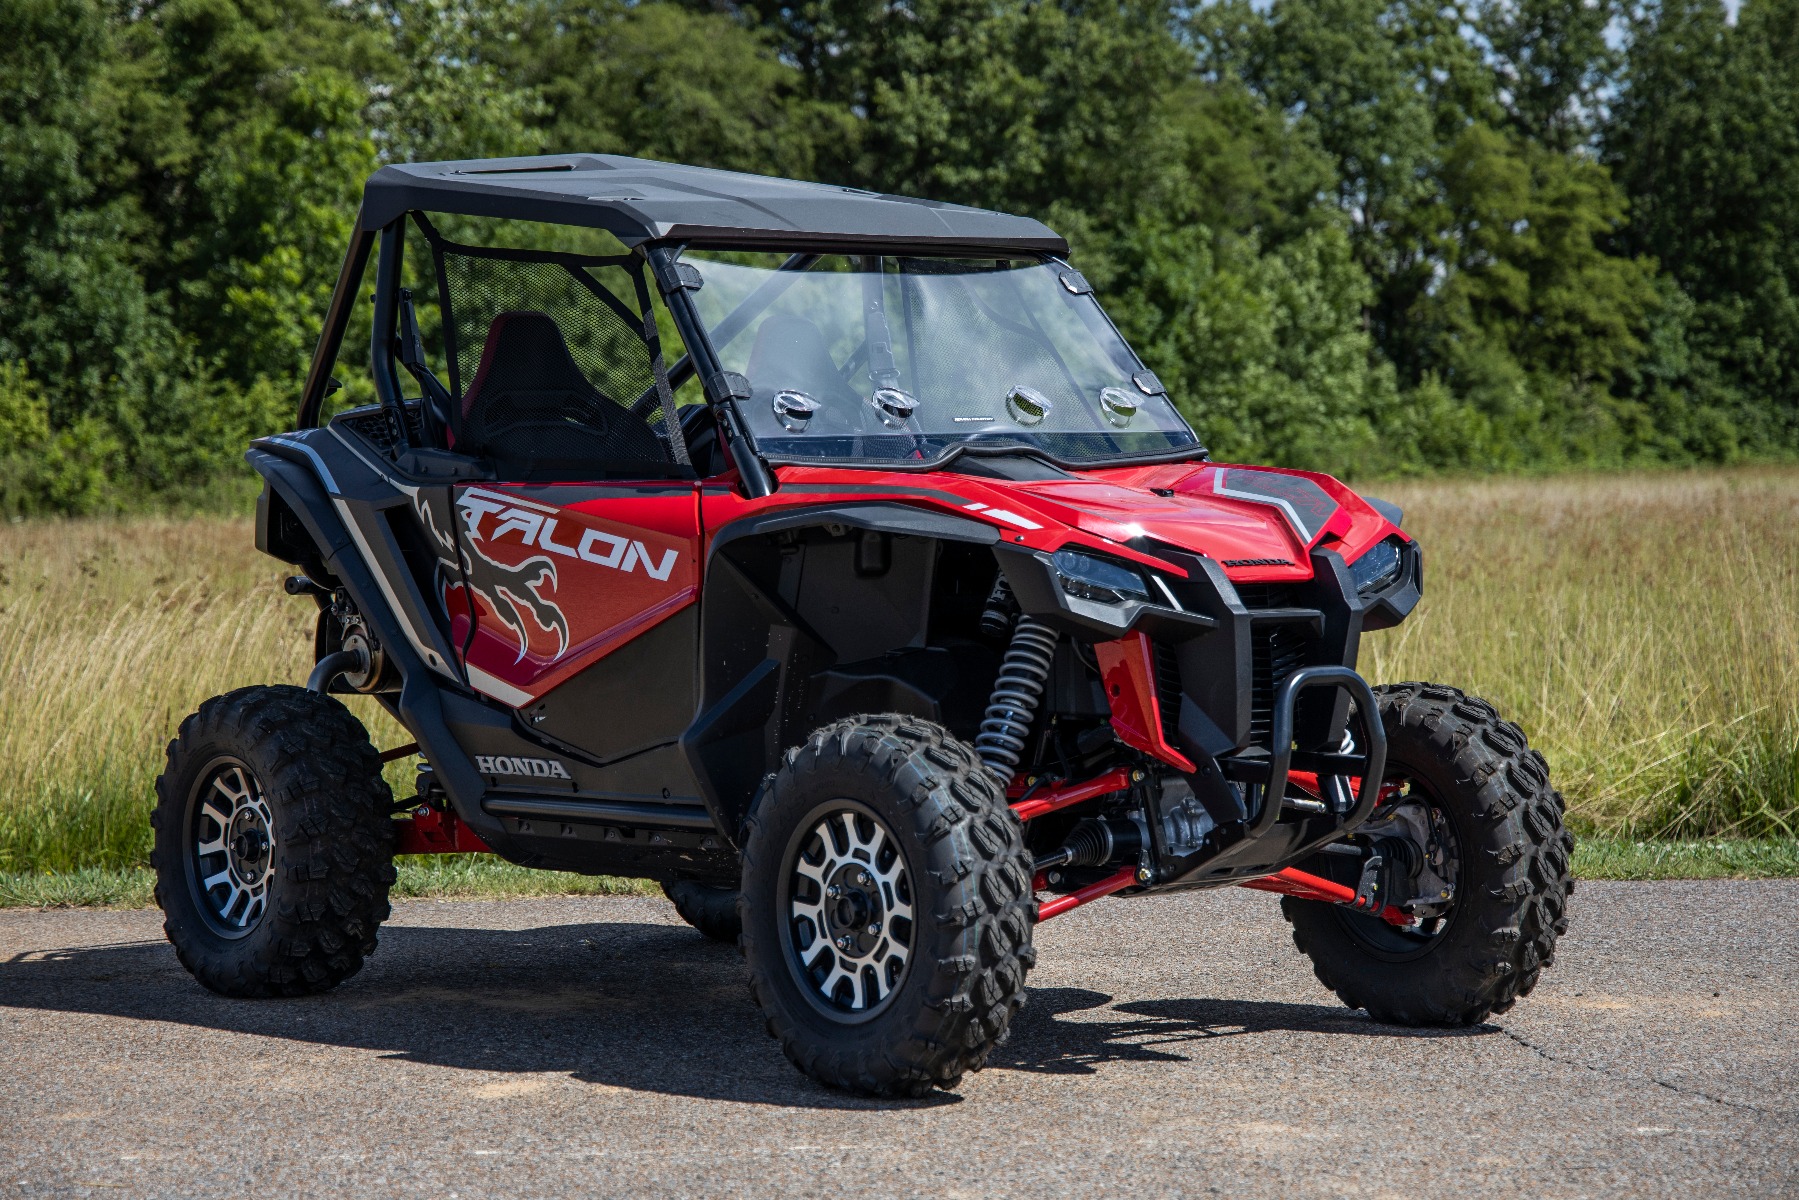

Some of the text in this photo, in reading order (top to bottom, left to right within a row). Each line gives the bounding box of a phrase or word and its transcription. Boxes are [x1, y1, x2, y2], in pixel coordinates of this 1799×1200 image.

[456, 487, 678, 581] TALON
[1221, 559, 1295, 567] HONDA
[991, 571, 1012, 600] FO
[475, 755, 572, 779] HONDA
